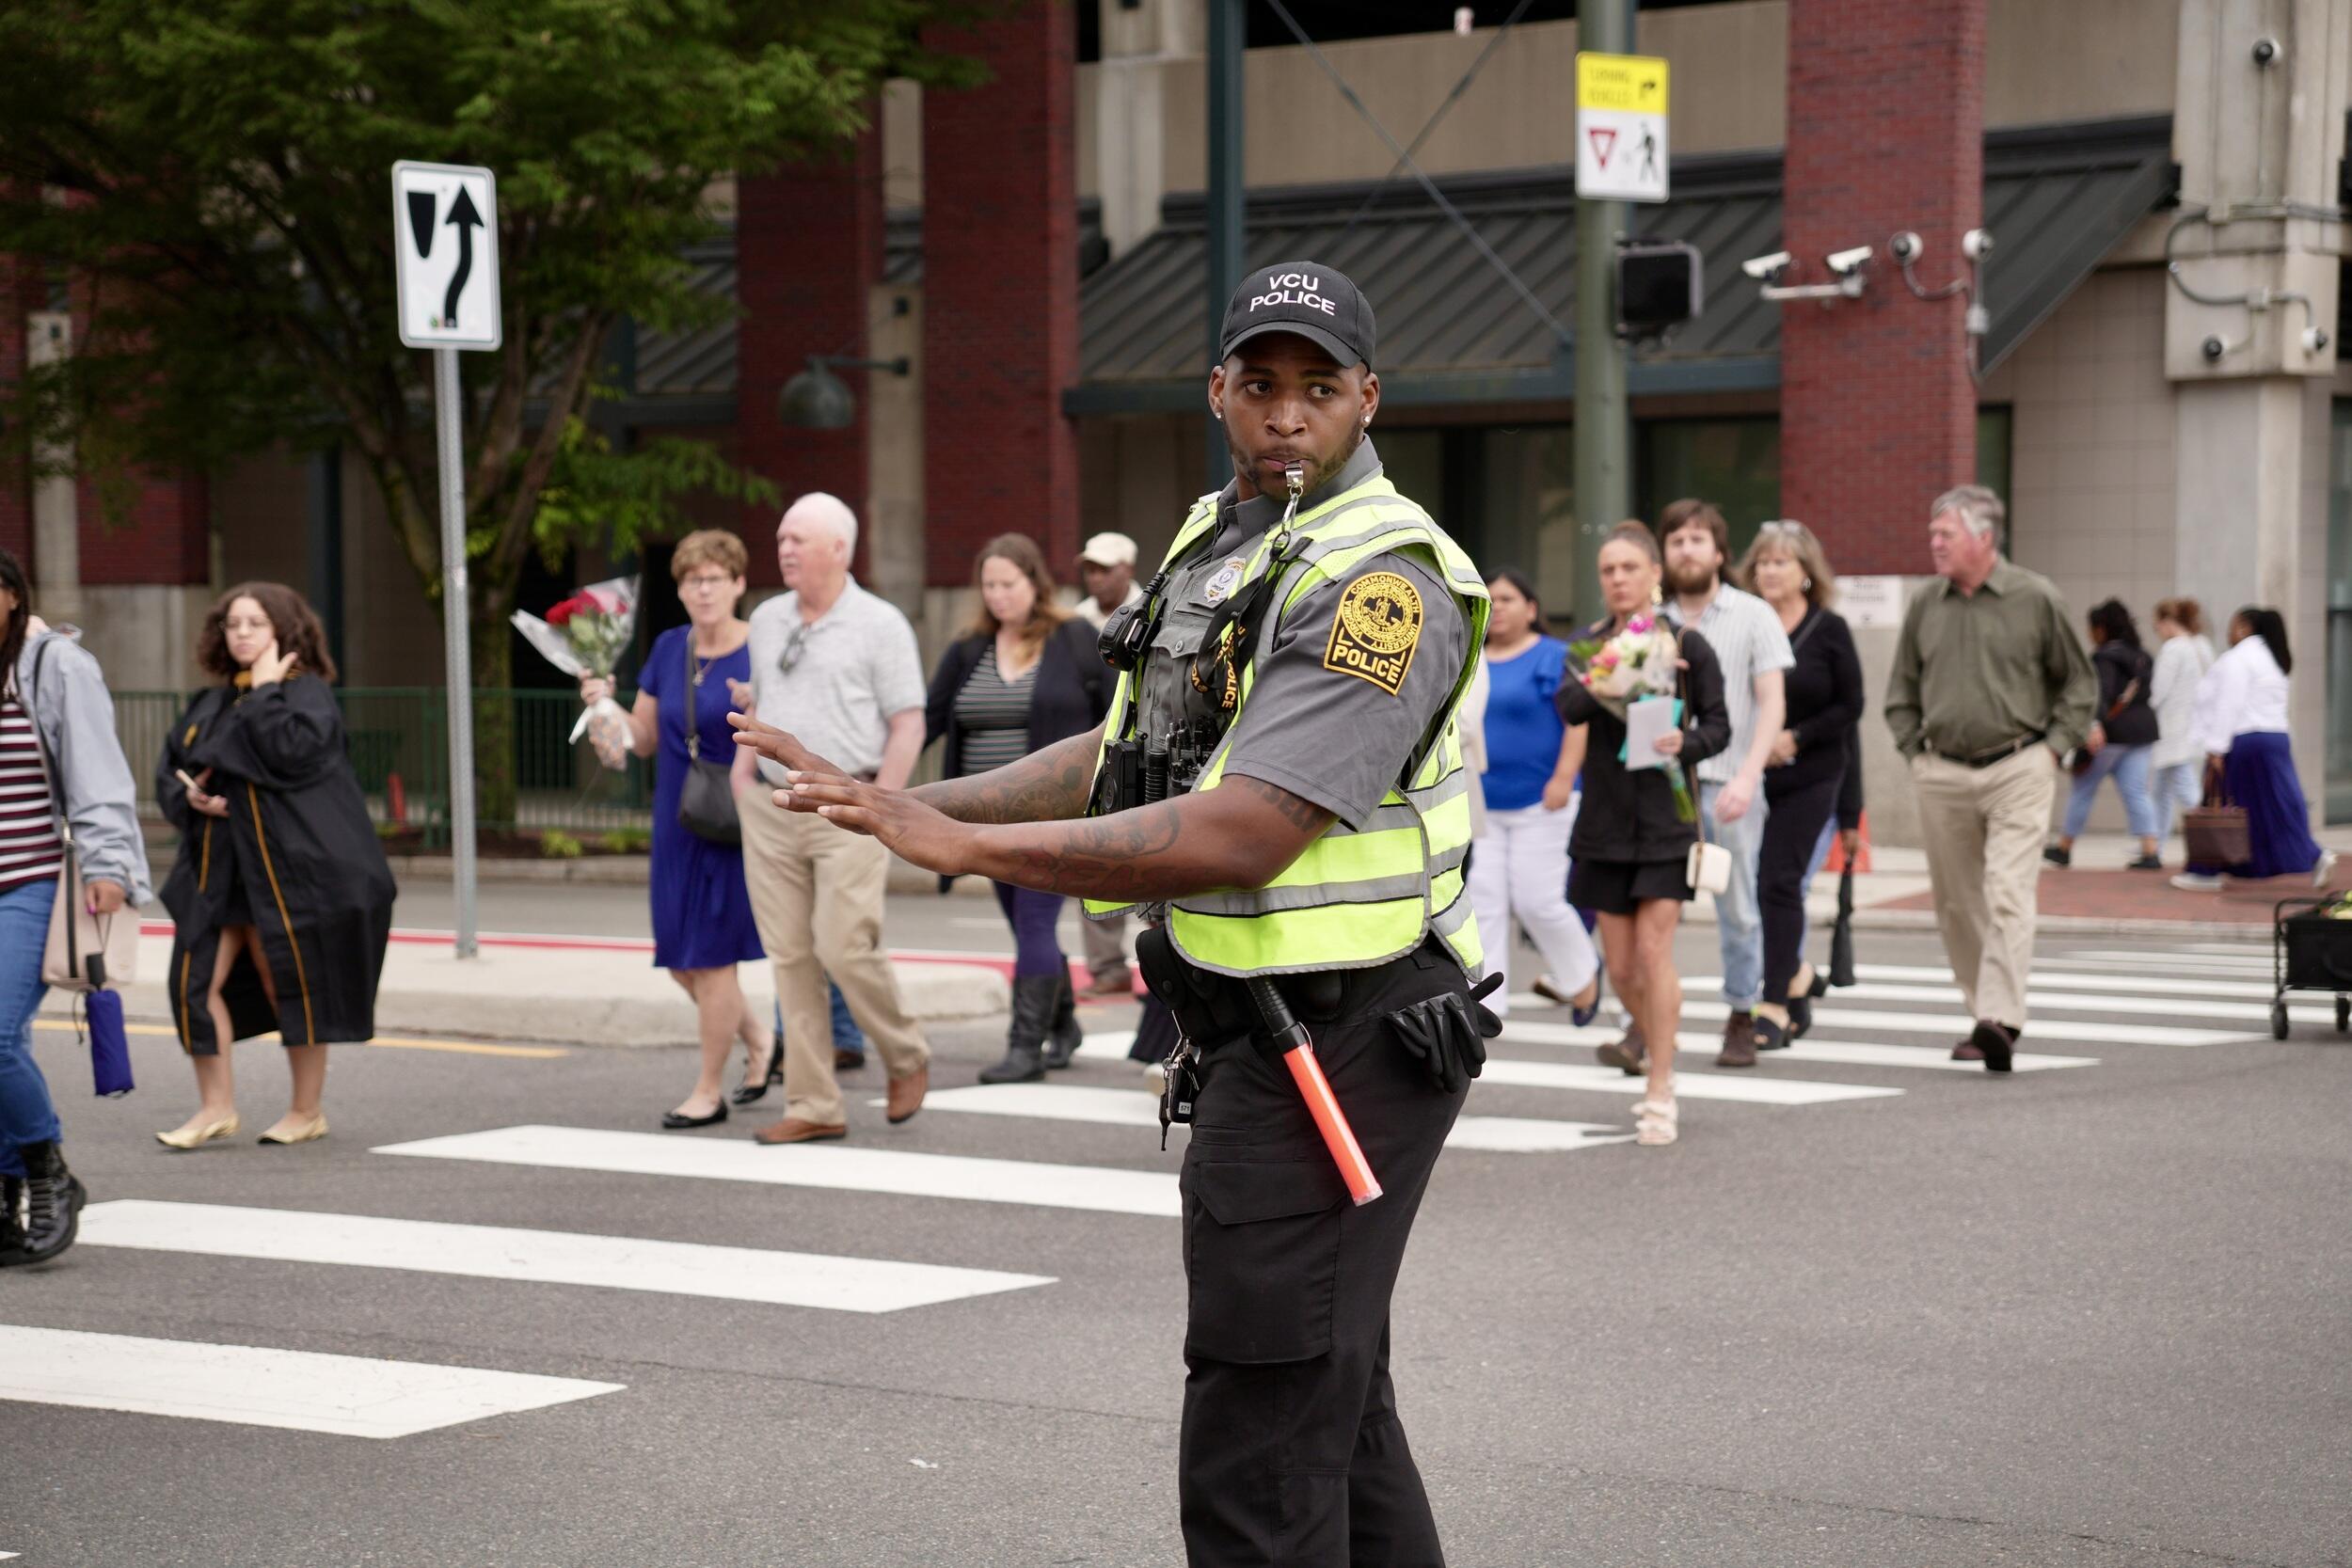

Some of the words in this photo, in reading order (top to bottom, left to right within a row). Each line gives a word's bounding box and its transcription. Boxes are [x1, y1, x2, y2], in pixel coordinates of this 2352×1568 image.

[1269, 273, 1318, 291] VCU
[1248, 289, 1336, 316] POLICE
[1350, 575, 1421, 614] COMMONWEALTH
[1343, 599, 1364, 640] VIRGINIA
[1370, 623, 1419, 651] UNIVERSITY
[1220, 660, 1237, 708] POLICE
[1331, 644, 1402, 685] POLICE
